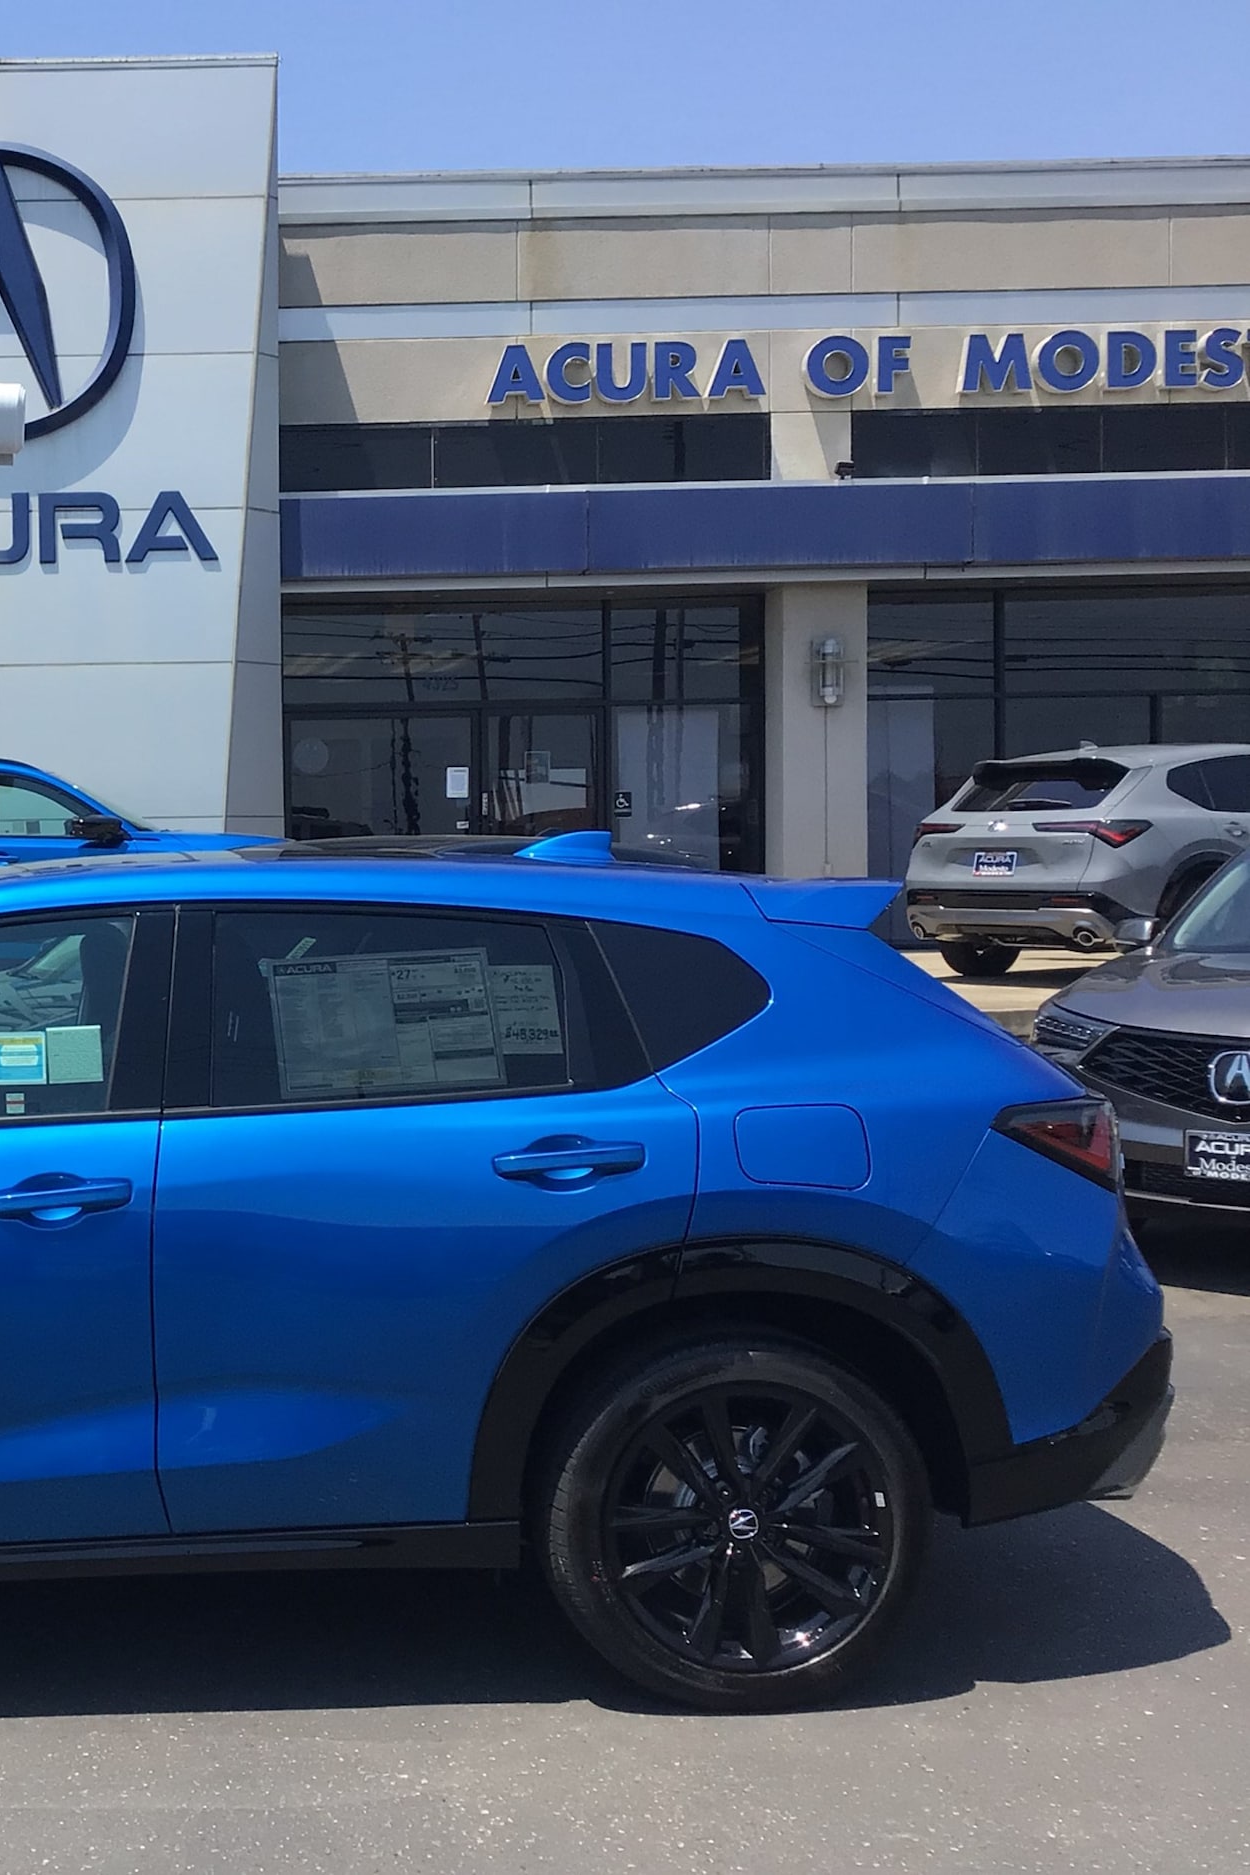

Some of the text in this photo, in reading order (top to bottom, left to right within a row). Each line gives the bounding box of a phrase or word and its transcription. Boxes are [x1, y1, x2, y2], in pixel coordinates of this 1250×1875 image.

[487, 328, 1250, 405] ACURA OF MODES
[286, 963, 333, 974] ACURA
[396, 969, 411, 980] 27
